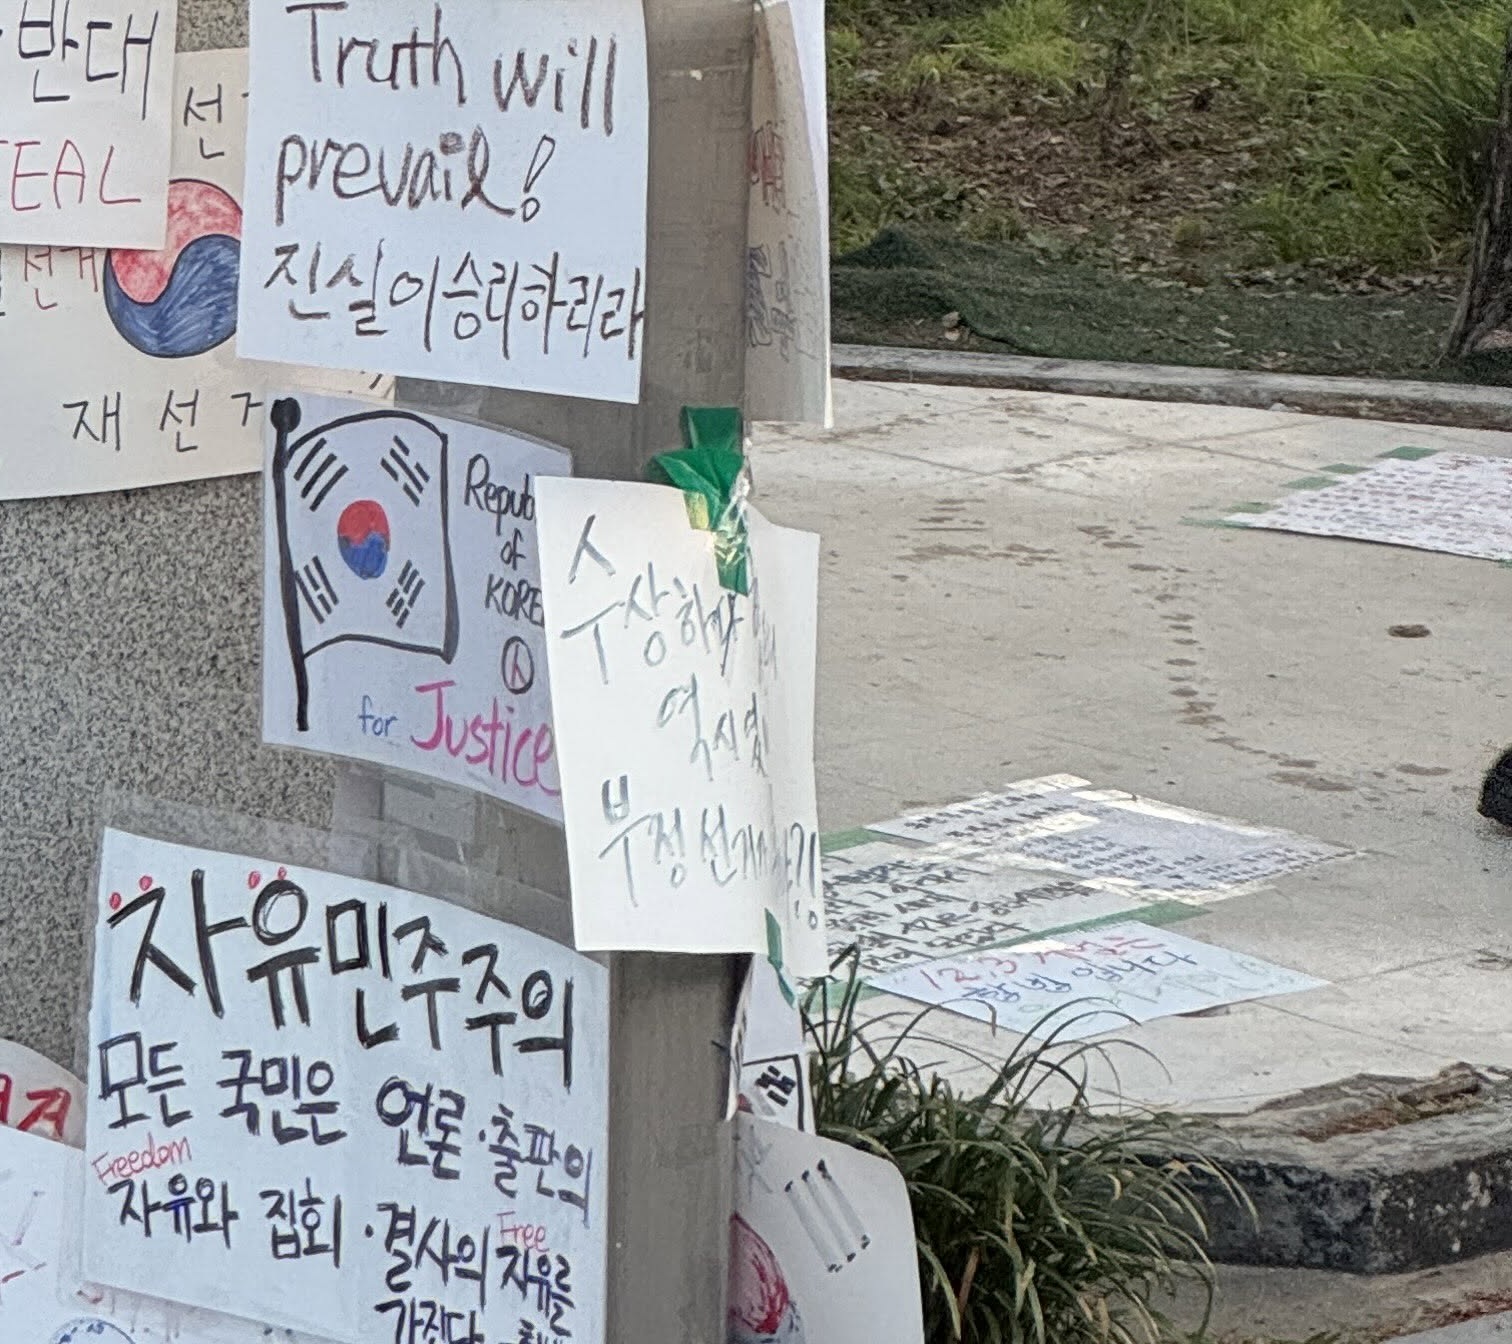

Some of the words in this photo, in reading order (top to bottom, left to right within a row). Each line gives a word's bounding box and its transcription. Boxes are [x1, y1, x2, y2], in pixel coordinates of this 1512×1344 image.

[285, 1, 468, 107] Truth
[493, 32, 618, 137] will
[274, 123, 557, 227] prevail!
[499, 527, 526, 572] of
[357, 694, 400, 739] for
[409, 679, 560, 797] Justice
[107, 867, 575, 1095] 자유민주주의
[98, 1032, 193, 1130] 모든
[216, 1049, 347, 1147] 국민은
[89, 1132, 192, 1184] Freedom
[106, 1172, 240, 1250] 자유와
[259, 1178, 341, 1268] 집회
[495, 1210, 550, 1254] Free
